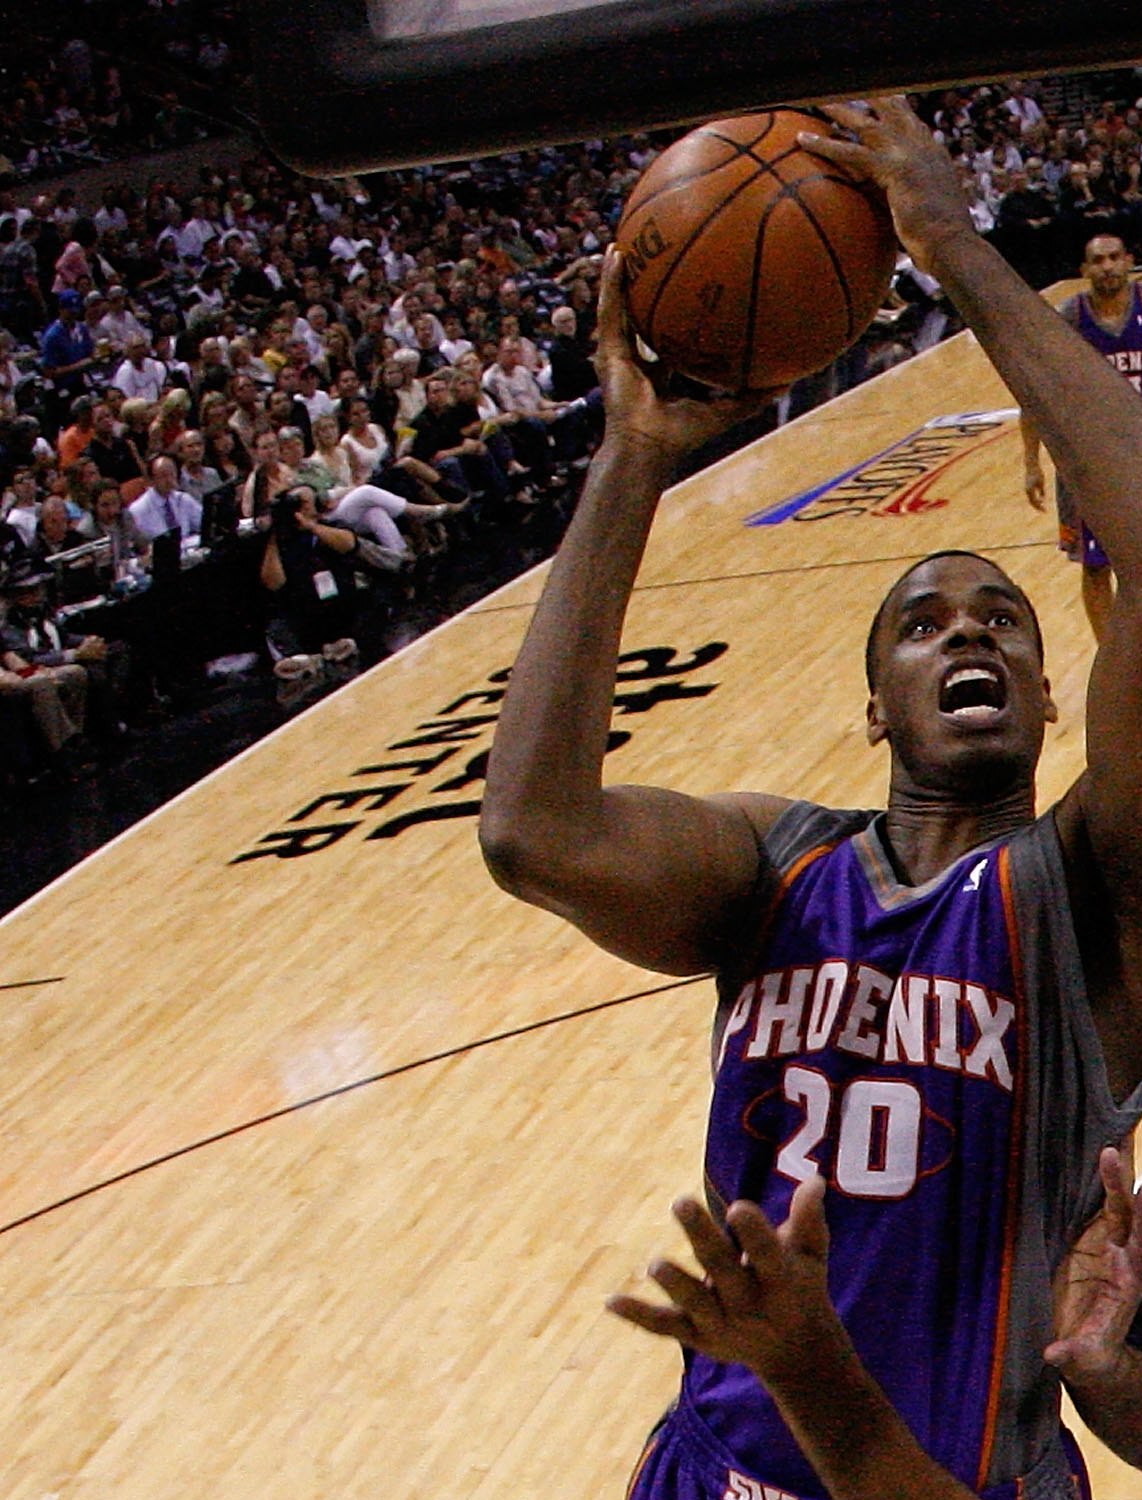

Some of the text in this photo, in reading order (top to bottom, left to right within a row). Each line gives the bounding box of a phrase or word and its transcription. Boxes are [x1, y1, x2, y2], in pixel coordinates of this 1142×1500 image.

[793, 421, 1004, 522] PLAYOFFS
[228, 666, 514, 866] ENTER
[715, 959, 1017, 1093] PHOENIX
[775, 1064, 923, 1198] 20
